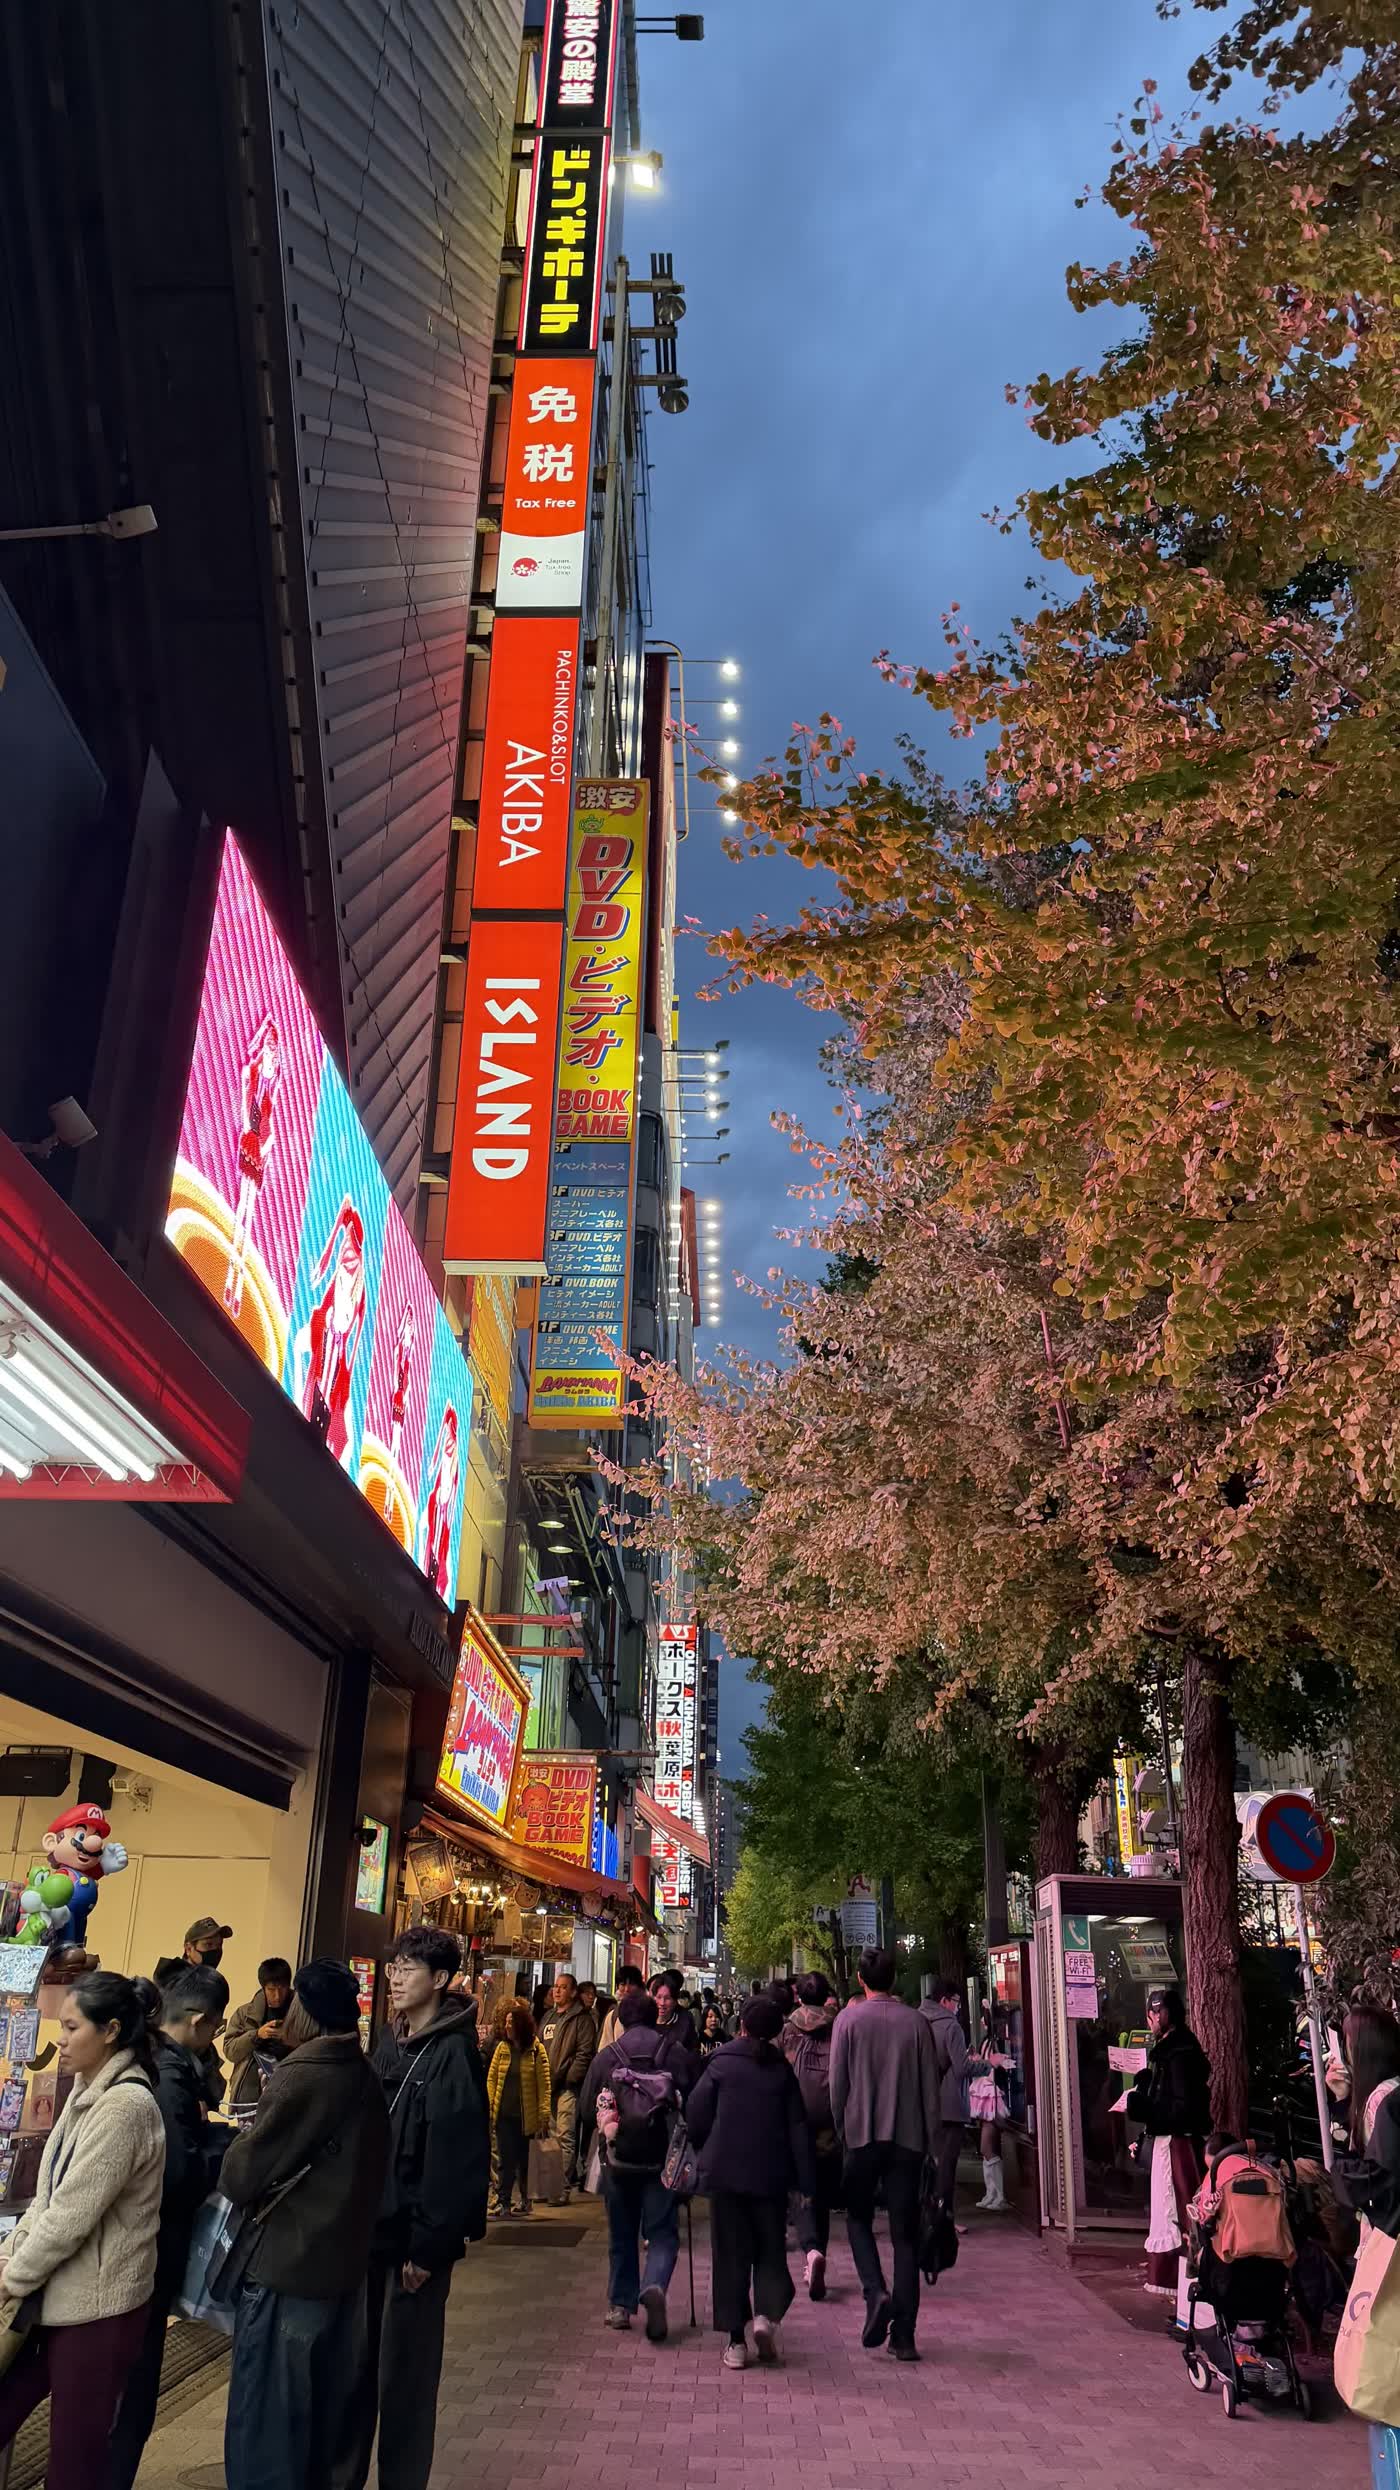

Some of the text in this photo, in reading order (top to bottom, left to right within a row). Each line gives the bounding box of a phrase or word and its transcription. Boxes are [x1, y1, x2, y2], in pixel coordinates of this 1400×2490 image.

[522, 385, 578, 483] 免税
[515, 498, 577, 508] Tax Free
[549, 650, 572, 785] PACHINKO&SLOT
[499, 740, 548, 867] AKIBA
[579, 786, 635, 809] 激安
[472, 977, 541, 1180] ISLAND
[558, 1088, 631, 1113] BOOK
[556, 1114, 631, 1138] GAME
[572, 1188, 595, 1197] DVD
[541, 1275, 562, 1286] 2F
[540, 1321, 559, 1332] 1F
[683, 1641, 696, 1686] VOLKS
[682, 1687, 696, 1768] AKIHABARA
[550, 1768, 591, 1790] DVD
[547, 1791, 589, 1811] ビデオ
[681, 1770, 693, 1820] HOBBY
[89, 1808, 102, 1819] M
[527, 1811, 585, 1829] BOOK
[524, 1827, 584, 1844] GAME
[679, 1896, 690, 1906] 2
[1068, 1958, 1089, 1967] FREE
[1068, 1967, 1090, 1976] Wi-Fi
